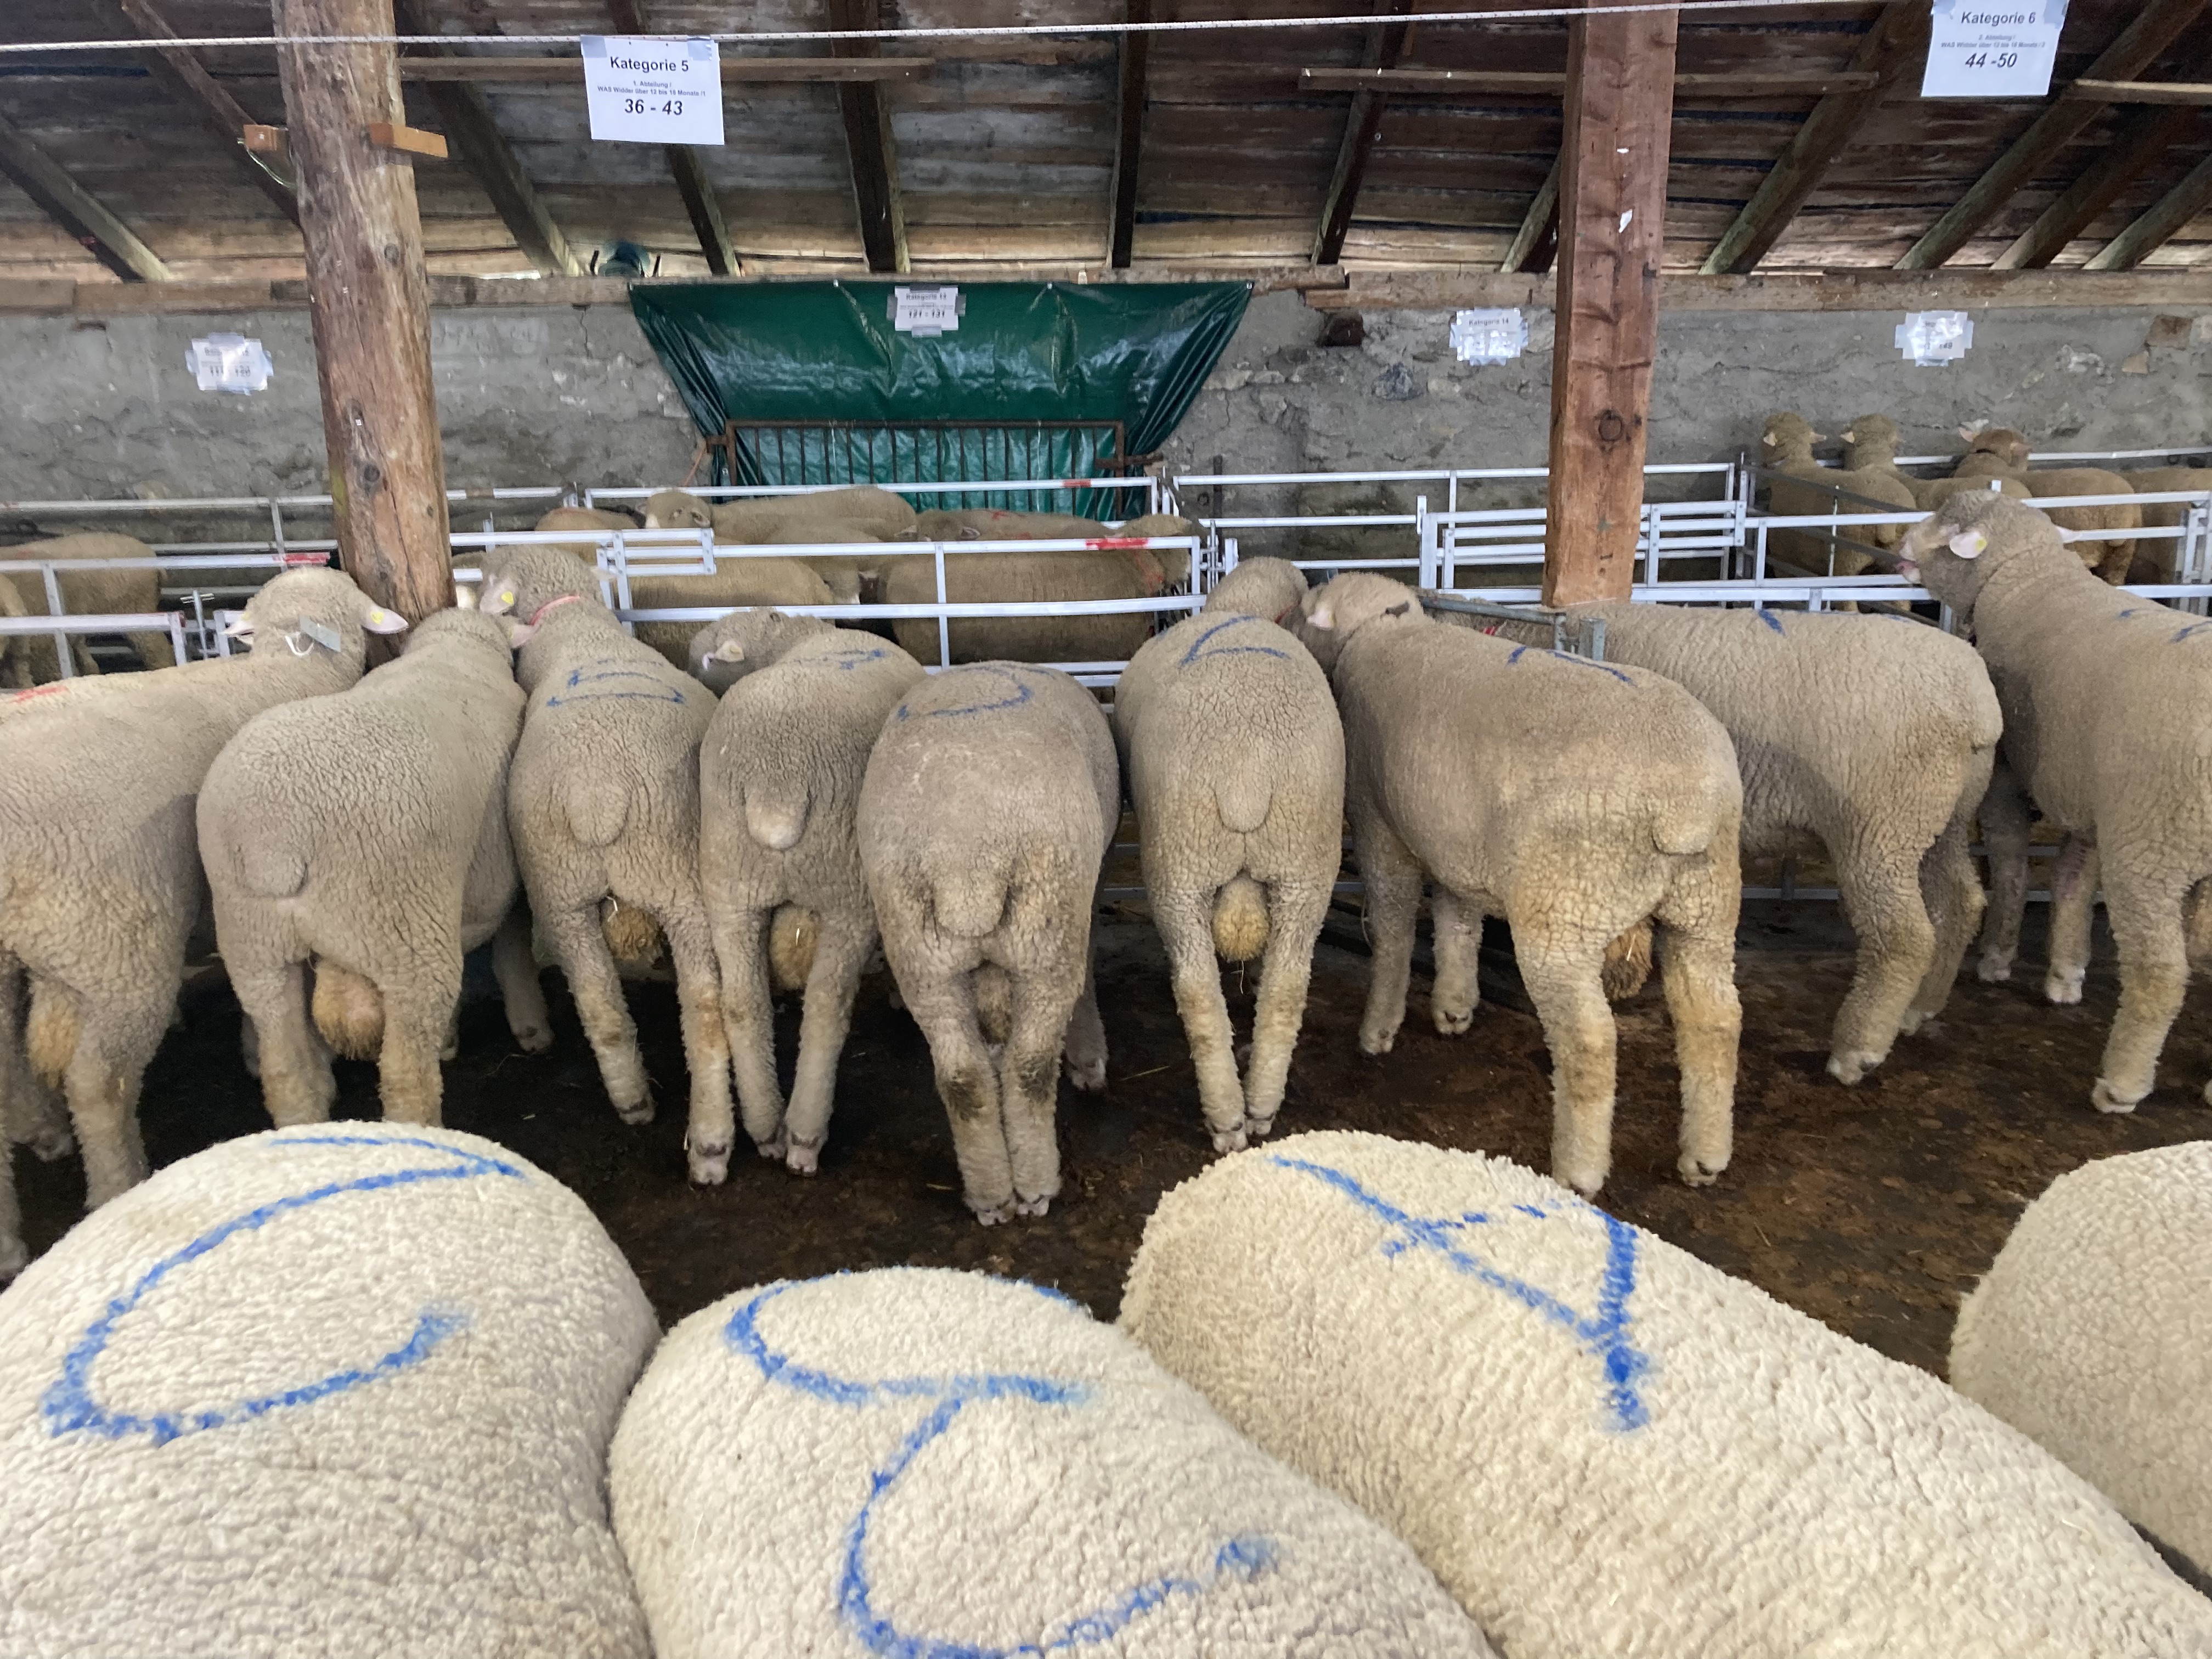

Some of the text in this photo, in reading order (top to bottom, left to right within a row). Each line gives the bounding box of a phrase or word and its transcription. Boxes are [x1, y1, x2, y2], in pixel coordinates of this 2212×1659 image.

[1961, 12, 2036, 26] Kategorie 6
[610, 56, 689, 73] Kategorie 5
[1965, 53, 1988, 67] 44
[624, 98, 644, 114] 36
[662, 100, 682, 116] 43
